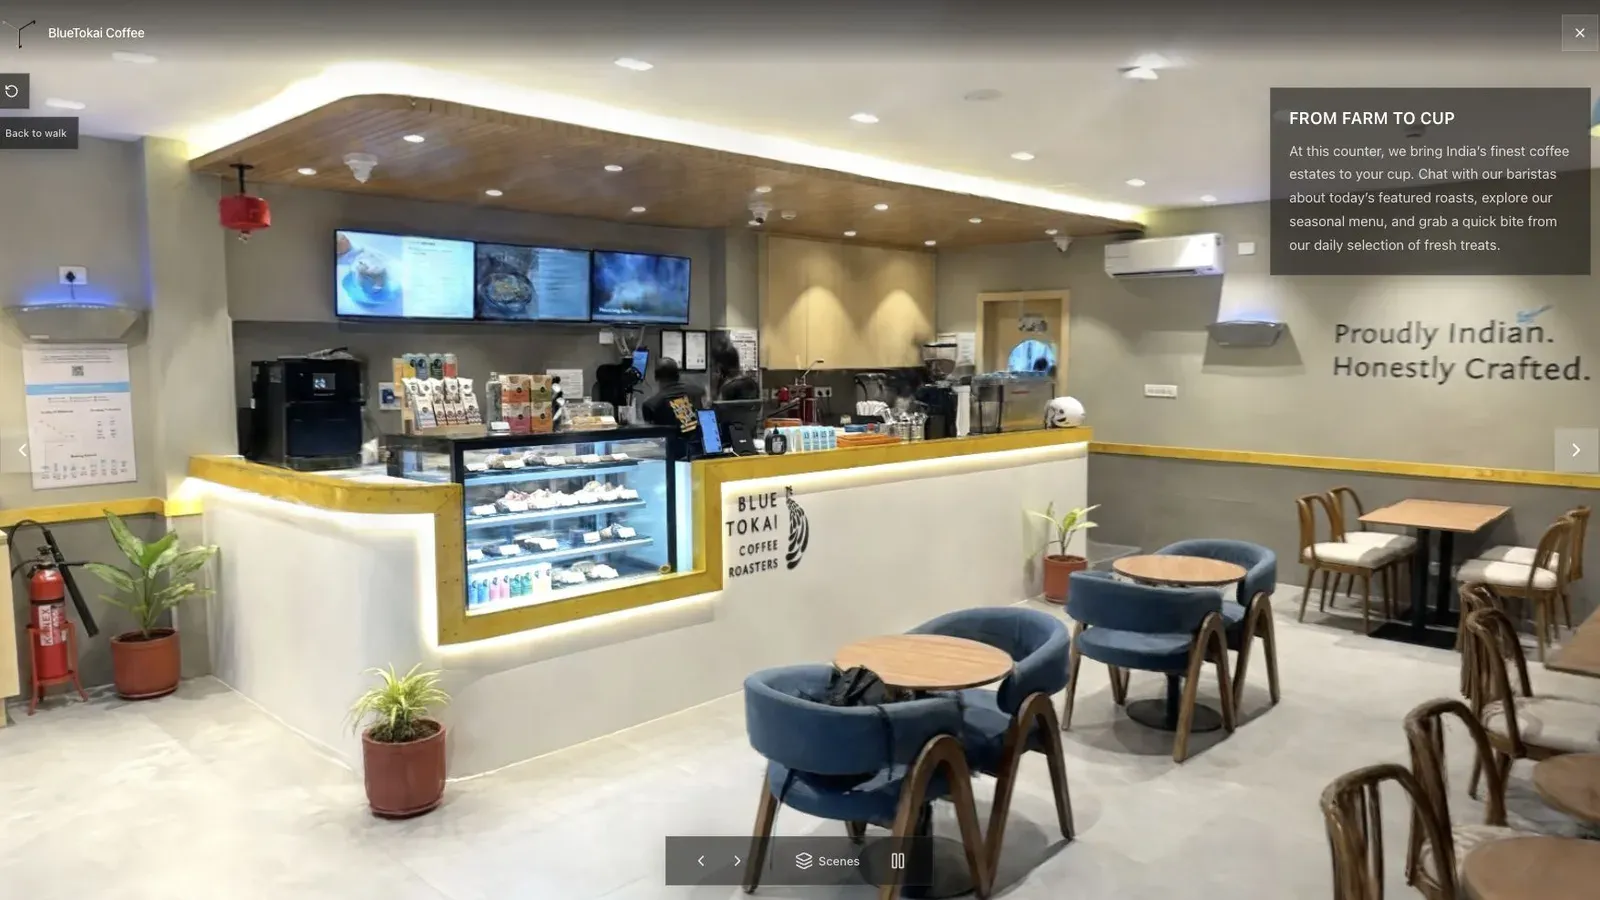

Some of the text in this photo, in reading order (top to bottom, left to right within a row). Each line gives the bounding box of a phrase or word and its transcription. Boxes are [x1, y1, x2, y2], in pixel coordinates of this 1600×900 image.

[1334, 319, 1555, 350] Proudly Indian.
[1333, 355, 1591, 385] Honestly Crafted.
[738, 492, 778, 512] BLUE
[725, 514, 778, 536] TOKAI
[739, 540, 778, 556] COFFEE
[728, 558, 779, 577] ROASTERS
